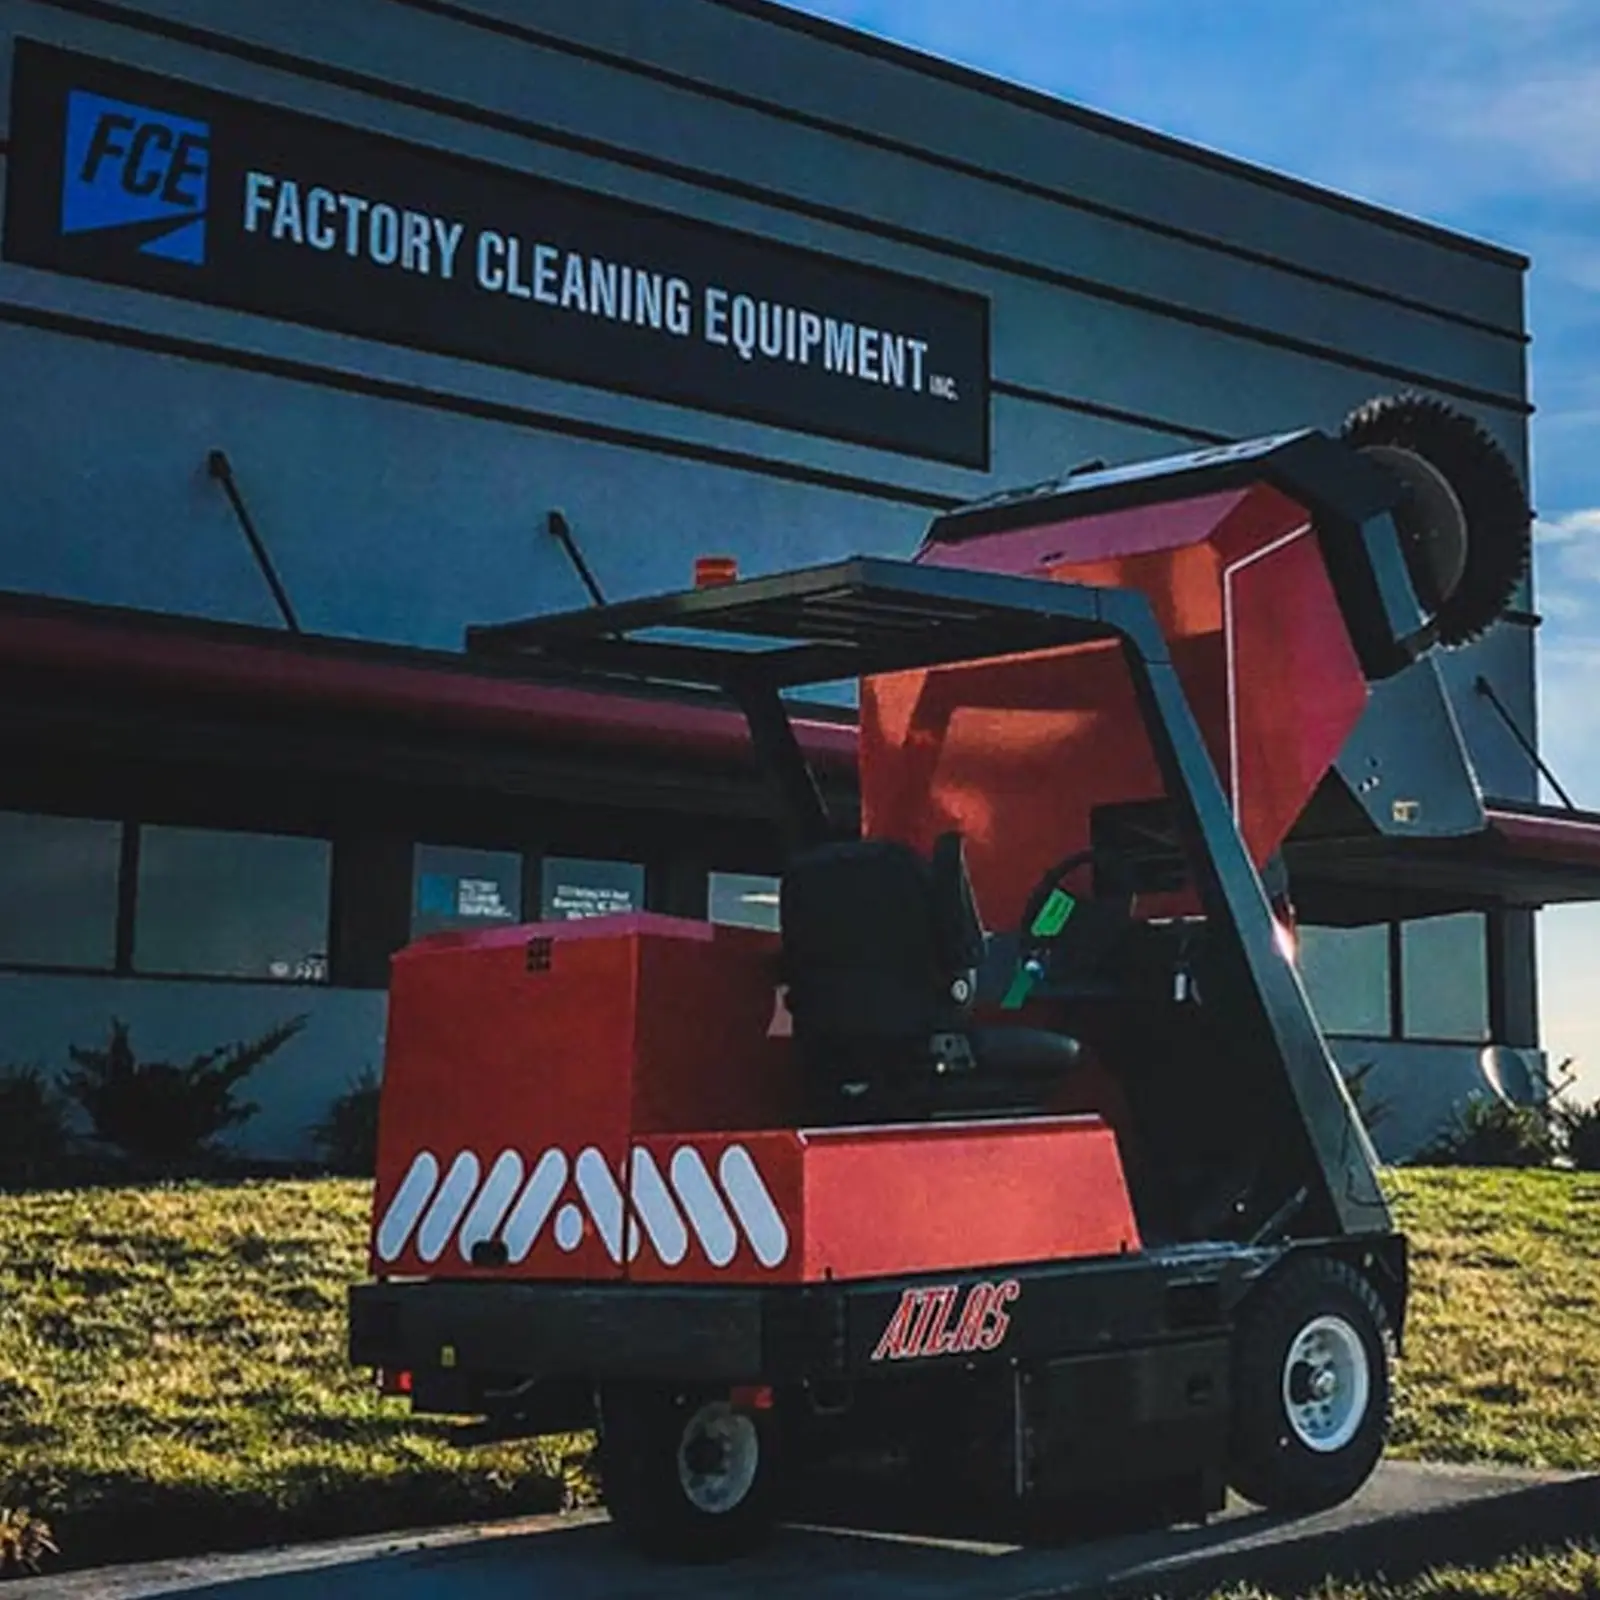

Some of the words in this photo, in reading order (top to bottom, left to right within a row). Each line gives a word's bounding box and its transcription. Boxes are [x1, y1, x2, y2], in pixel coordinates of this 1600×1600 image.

[81, 113, 209, 206] FCE
[244, 172, 464, 280] FACTORY
[477, 231, 691, 336] CLEANING
[705, 287, 929, 392] EQUIPMENT
[870, 1280, 1021, 1360] ATLAS
